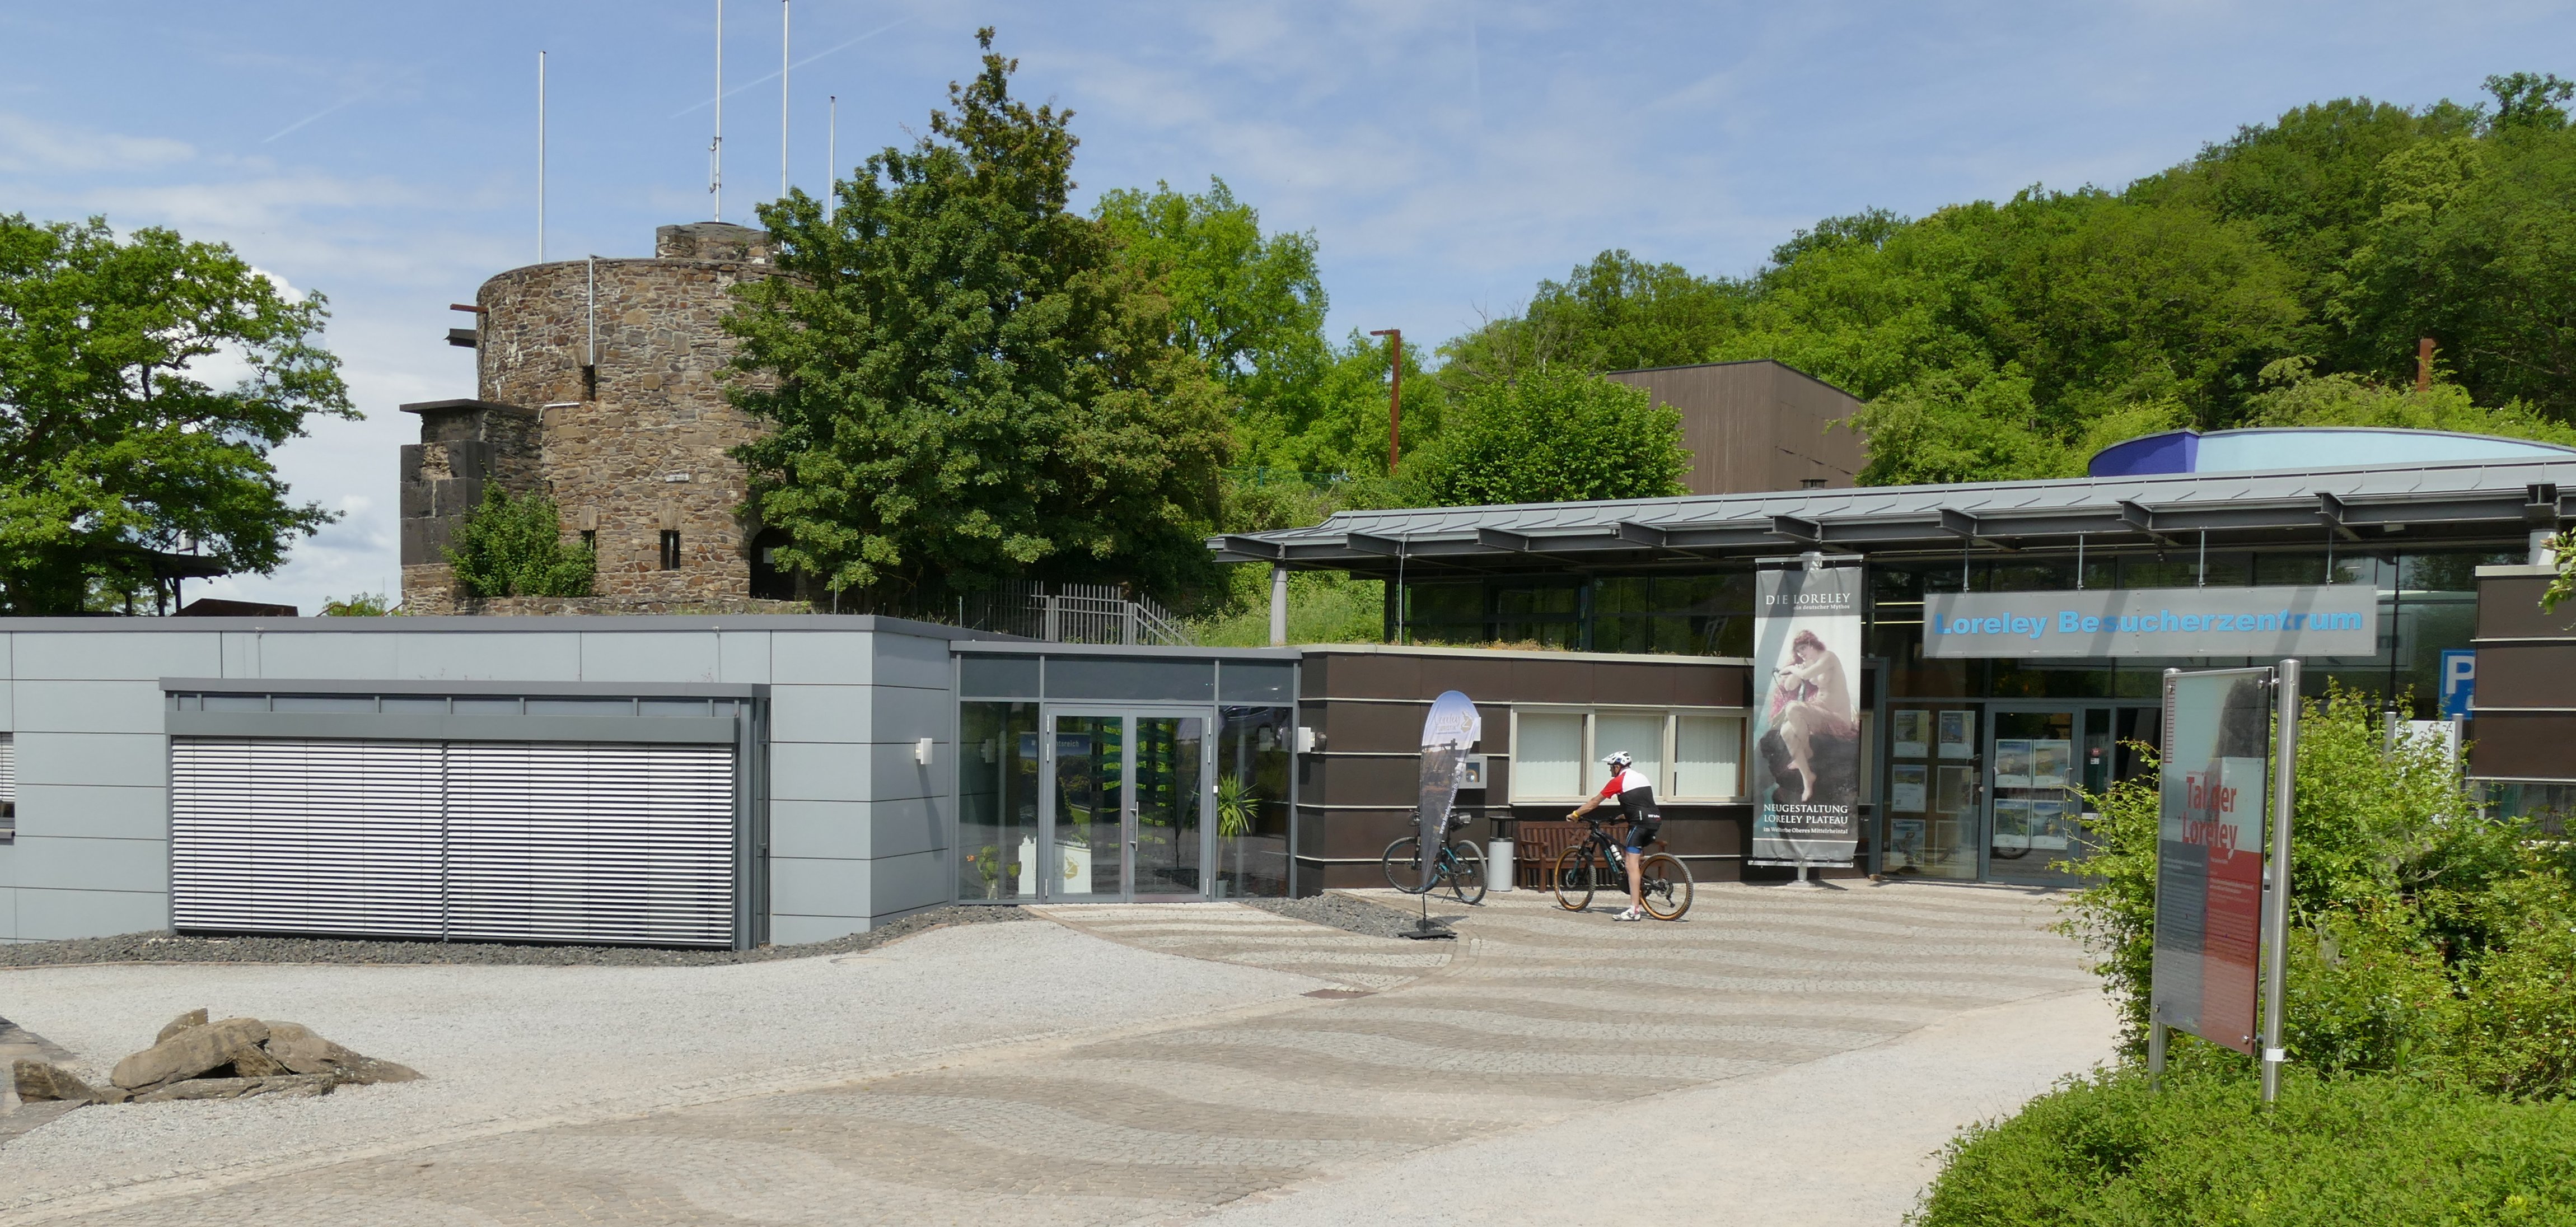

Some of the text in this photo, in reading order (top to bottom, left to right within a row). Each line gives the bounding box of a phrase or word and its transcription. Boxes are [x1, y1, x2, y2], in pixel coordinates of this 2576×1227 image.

[1766, 593, 1850, 605] DIE LORELEY
[1934, 609, 2362, 640] Loreley Besucherzentrum
[2186, 776, 2237, 813] Tal der
[1764, 804, 1848, 813] NEUGESTALTUNG
[1764, 814, 1848, 824] LORELEY PLATEAU
[2182, 811, 2238, 860] Loreley
